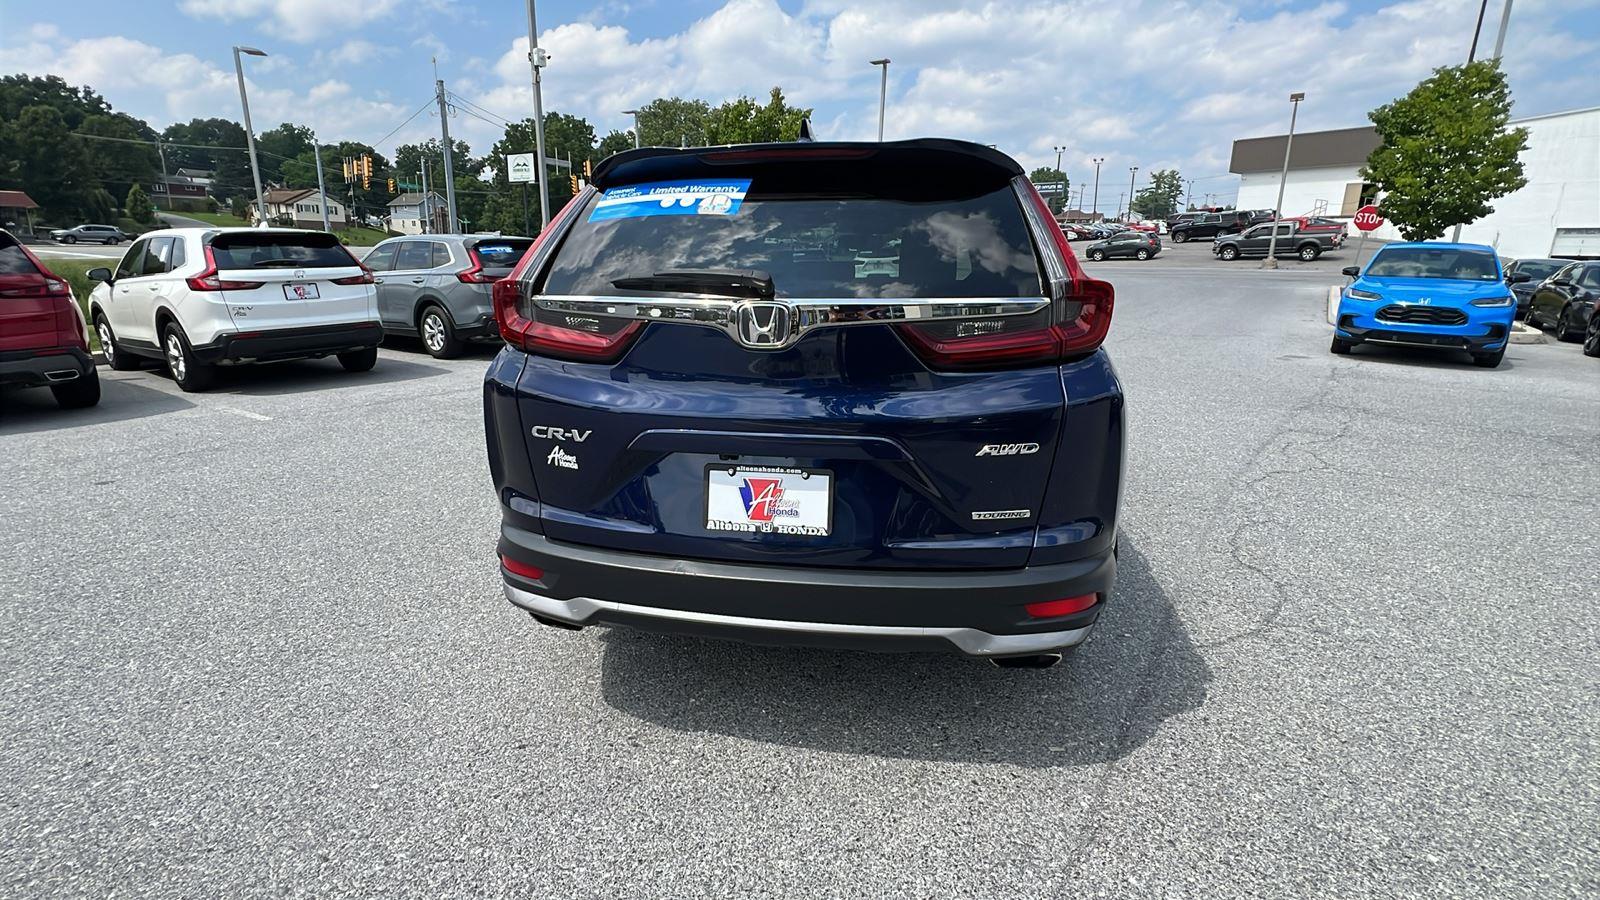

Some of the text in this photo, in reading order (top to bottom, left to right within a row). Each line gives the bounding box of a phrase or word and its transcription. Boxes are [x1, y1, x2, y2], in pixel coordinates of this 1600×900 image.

[649, 185, 741, 195] Limited Warranty
[1355, 212, 1384, 224] STOP
[531, 425, 592, 442] CR-V
[975, 442, 1040, 457] AWD
[560, 460, 579, 470] Honda
[736, 466, 802, 474] altoonahonda.com
[769, 506, 799, 516] Honda
[975, 511, 1028, 519] TOURING
[706, 520, 829, 537] Altoona HONDA
